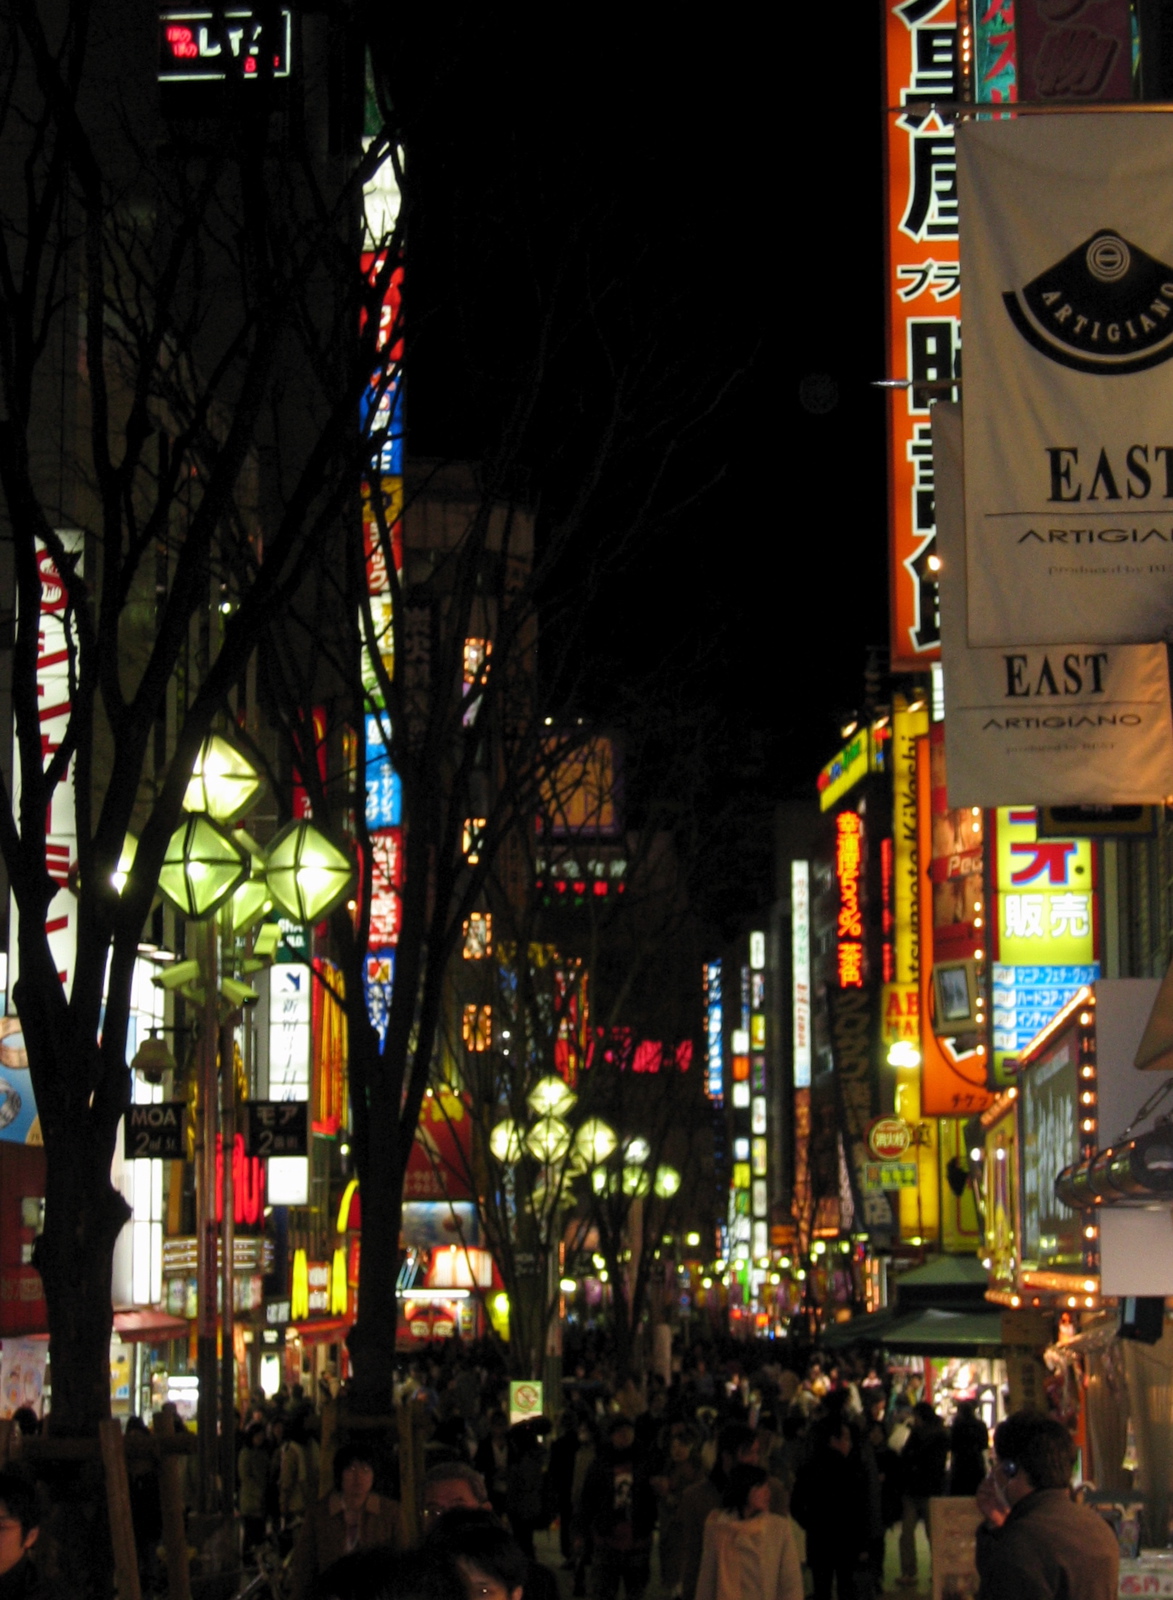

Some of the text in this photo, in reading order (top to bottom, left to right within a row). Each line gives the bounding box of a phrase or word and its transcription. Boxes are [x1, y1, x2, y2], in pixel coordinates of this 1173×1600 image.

[1041, 282, 1173, 342] ARTIGIANO
[1045, 443, 1173, 503] EAST
[1017, 527, 1173, 544] ARTIGIA
[1003, 652, 1109, 698] EAST
[982, 713, 1142, 731] ARTIGIANO
[1004, 892, 1090, 939] 販売
[131, 1107, 177, 1128] MOA
[256, 1105, 299, 1126] モア
